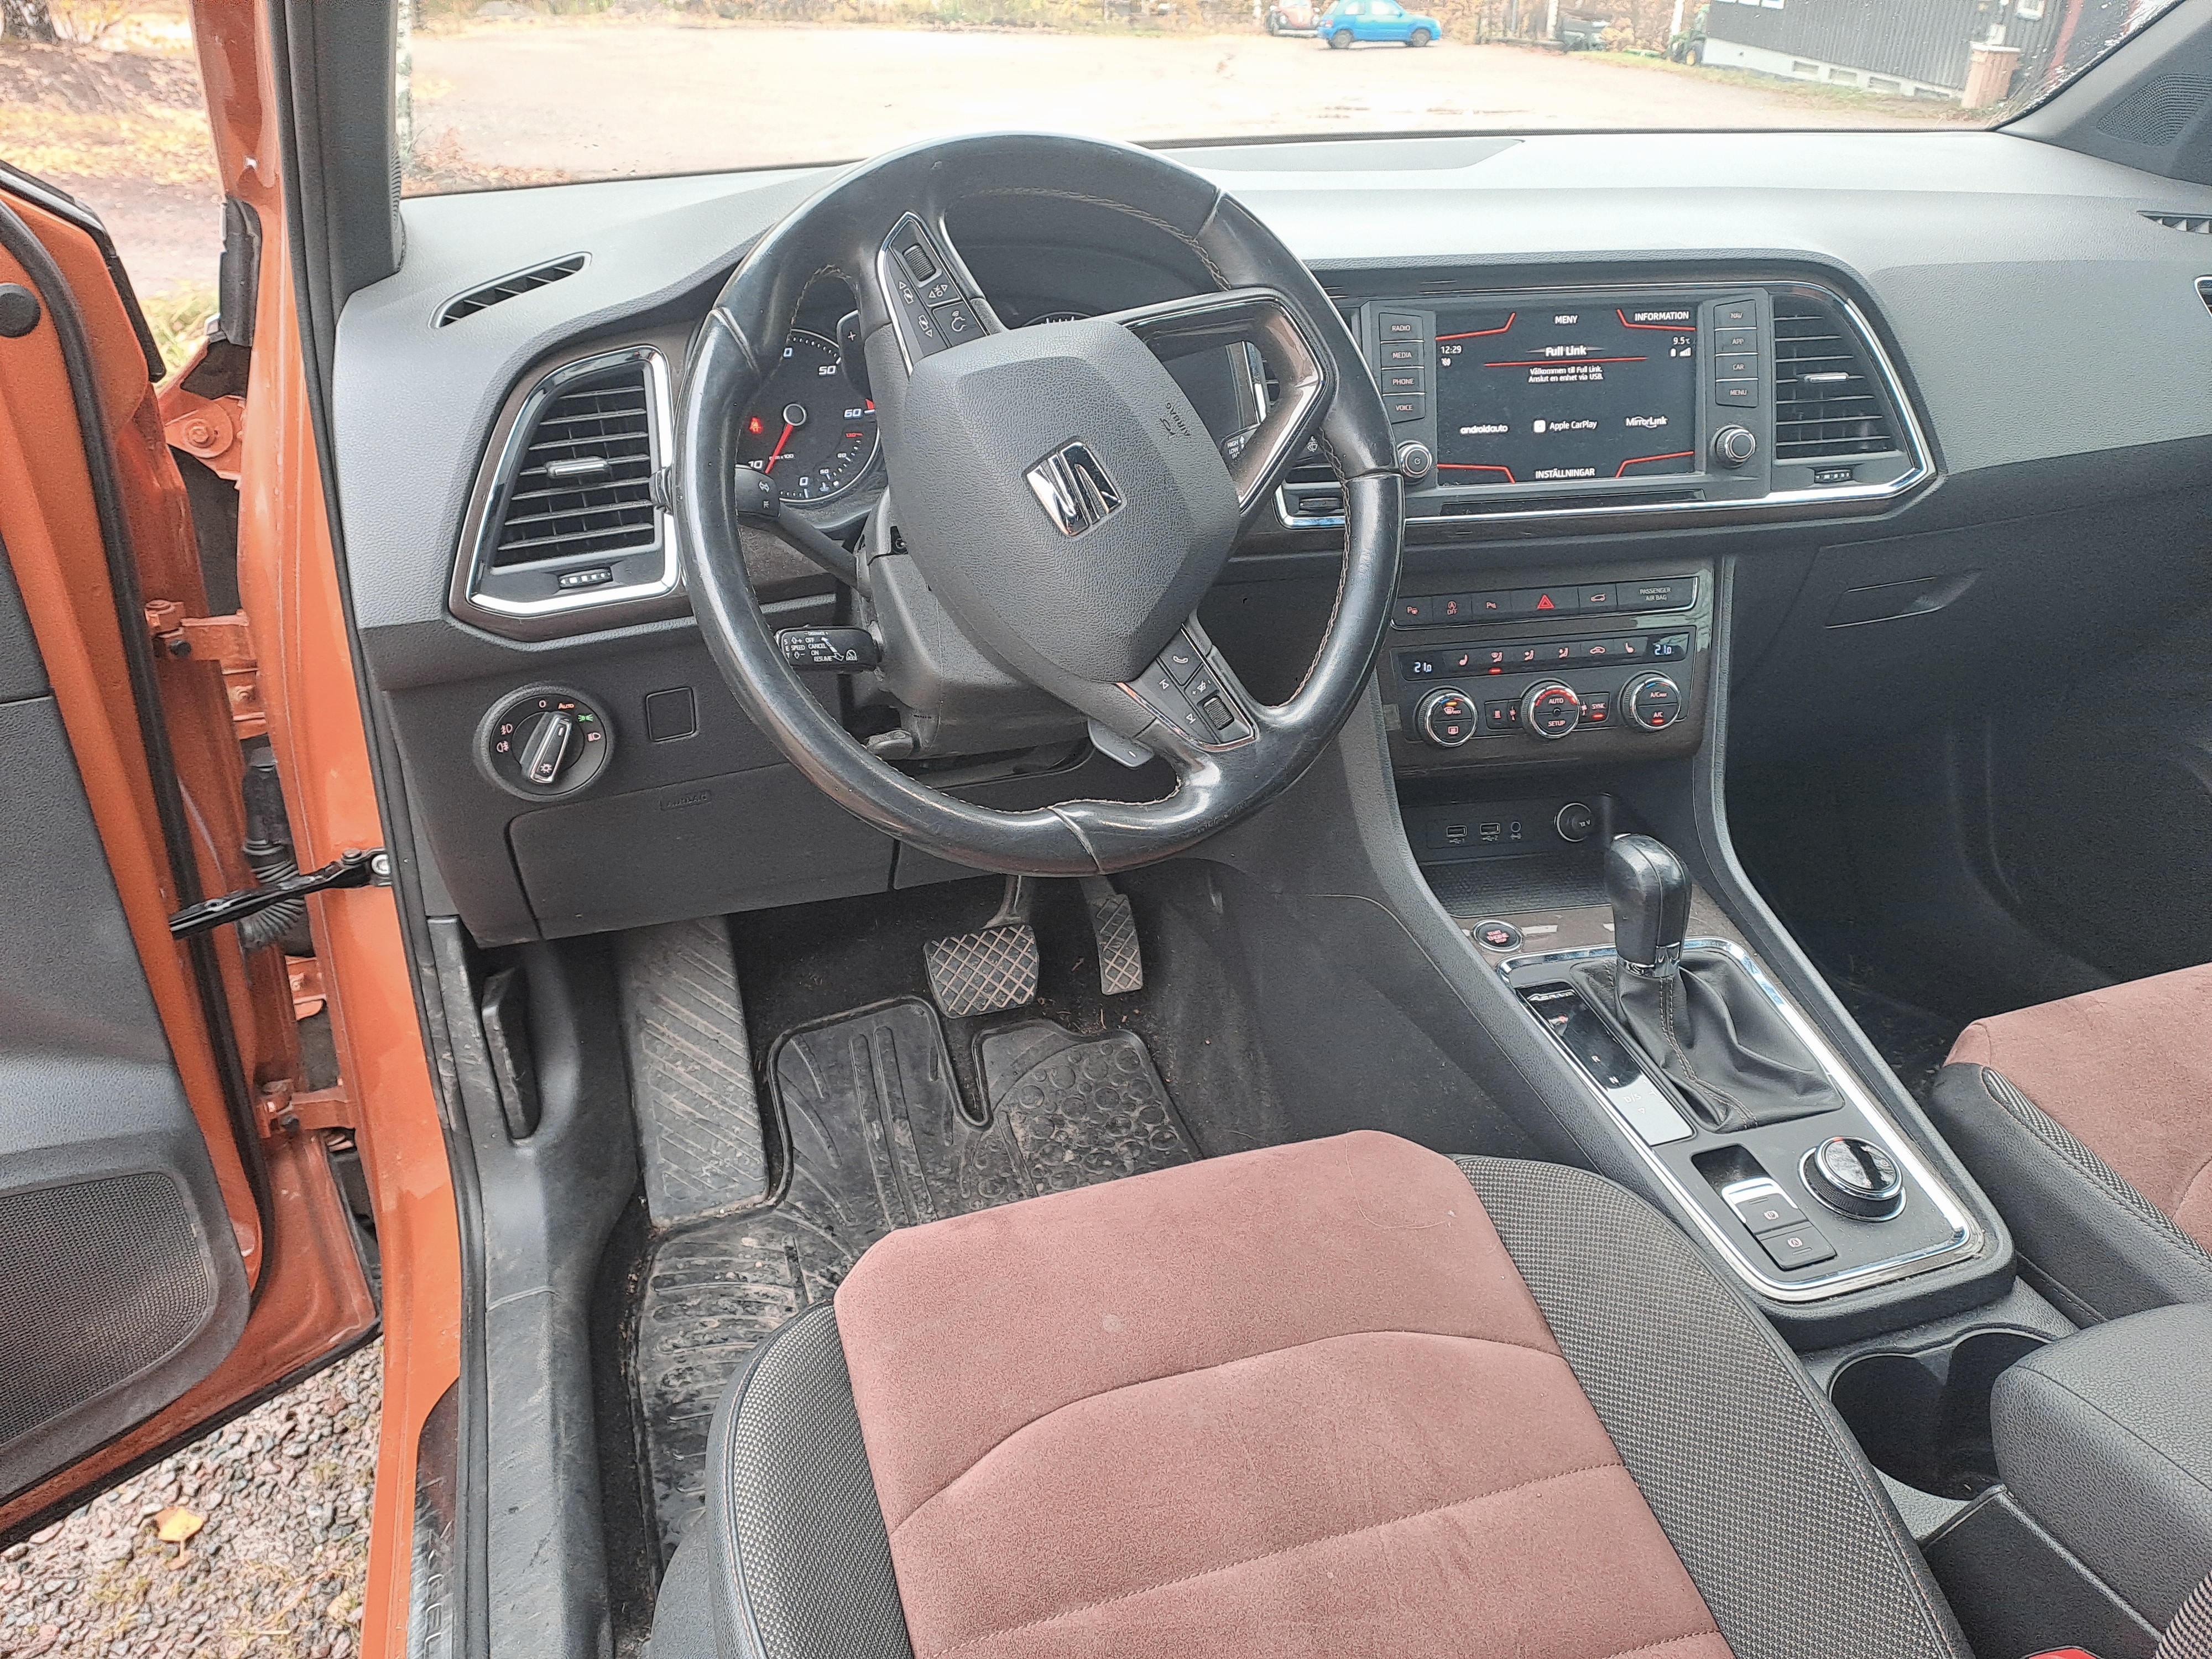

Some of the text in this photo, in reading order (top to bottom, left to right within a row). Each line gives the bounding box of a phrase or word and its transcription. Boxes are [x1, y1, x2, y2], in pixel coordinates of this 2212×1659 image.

[1554, 315, 1578, 324] MENY
[1635, 311, 1689, 321] INFORMATION
[1441, 345, 1462, 354] 12:29
[1546, 345, 1587, 357] Full Link
[818, 365, 836, 375] 50
[844, 408, 862, 418] 60
[1550, 420, 1598, 431] Apple CarPlay
[1626, 416, 1668, 428] MirrorLink
[748, 460, 763, 469] 10
[1535, 469, 1595, 479] INSTÄLLNINGAR
[799, 477, 808, 486] 0
[1623, 1093, 1642, 1103] D/S
